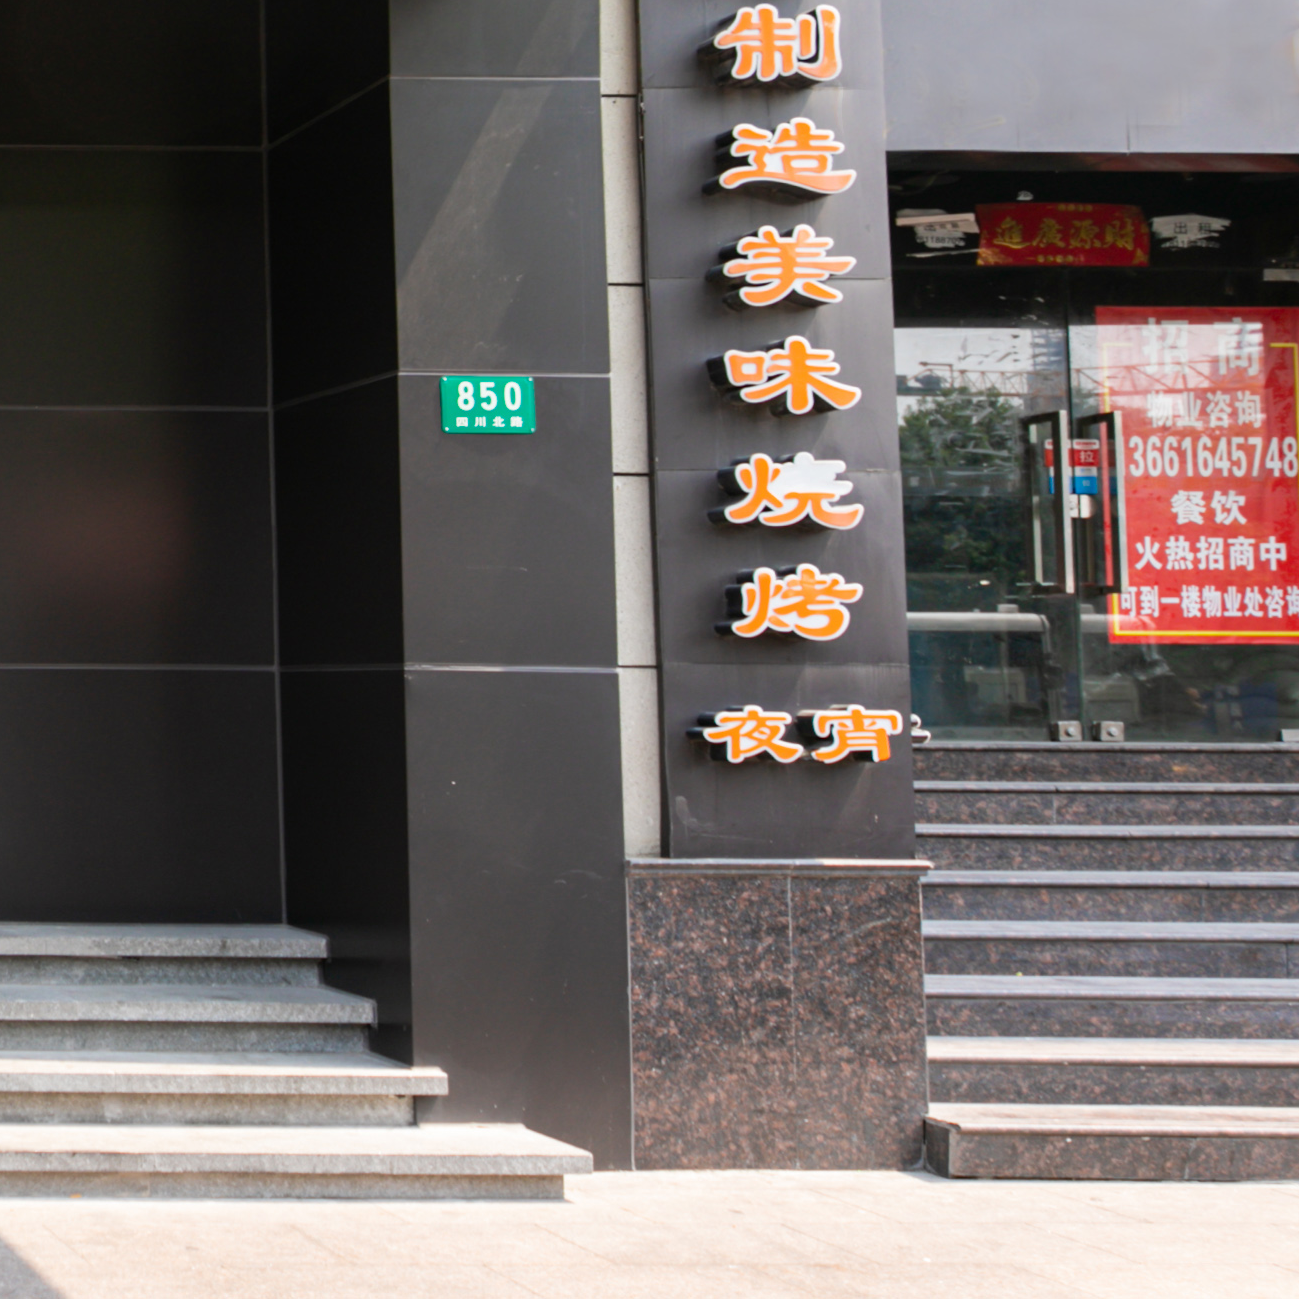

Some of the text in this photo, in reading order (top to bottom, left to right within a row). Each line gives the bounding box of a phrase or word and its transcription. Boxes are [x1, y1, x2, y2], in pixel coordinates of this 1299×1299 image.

[1141, 317, 1262, 376] 招商
[456, 381, 522, 411] 850
[1146, 390, 1262, 429] 物业咨询
[455, 416, 524, 428] 四川北路
[1122, 435, 1298, 477] 3661645748
[1170, 490, 1247, 525] 餐饮
[1134, 536, 1287, 571] 火热招商中
[704, 705, 902, 763] 夜宵
